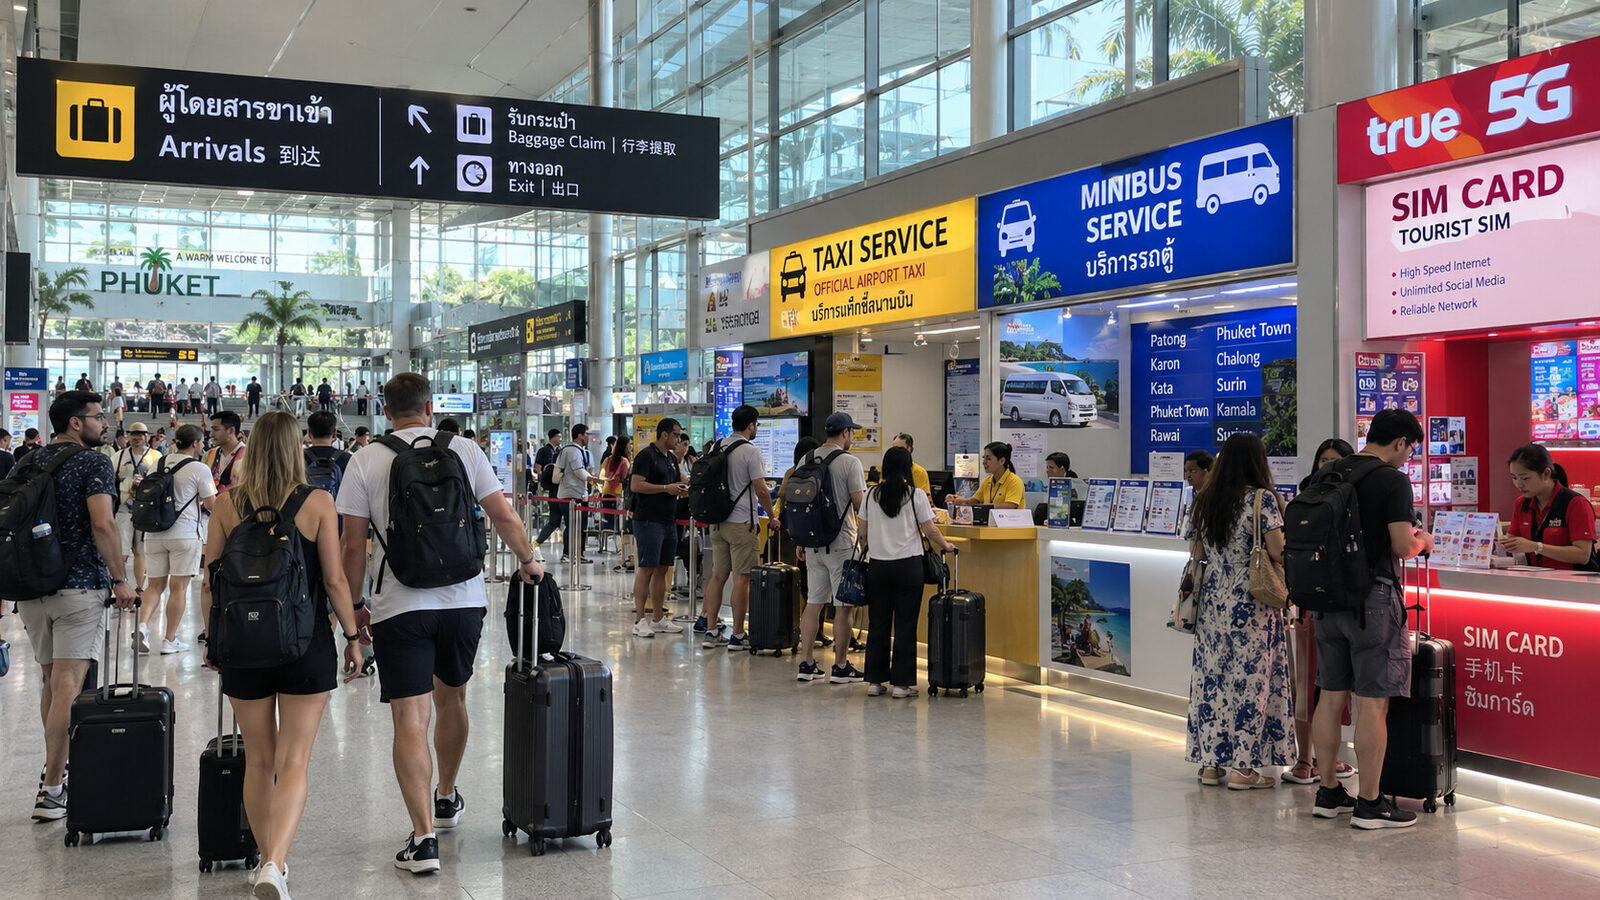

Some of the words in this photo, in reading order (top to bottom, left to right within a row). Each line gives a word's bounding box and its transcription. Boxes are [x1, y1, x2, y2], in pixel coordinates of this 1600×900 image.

[159, 82, 333, 125] ผู้โดยสารขาเข้า
[1366, 107, 1461, 156] true
[1485, 63, 1573, 136] 5G
[158, 135, 266, 164] Arrivals
[508, 130, 565, 150] Baggage
[569, 134, 606, 151] Claim
[279, 144, 322, 167] 到达
[508, 159, 564, 178] ทางออก
[509, 178, 535, 194] Exit
[551, 181, 579, 197] 出口
[1081, 162, 1182, 210] MINIBUS
[1392, 184, 1448, 222] SIM
[1461, 163, 1565, 209] CARD
[1086, 199, 1182, 243] SERVICE
[1399, 218, 1472, 245] TOURIST
[1478, 212, 1511, 233] SIM
[813, 239, 853, 272] TAXI
[860, 217, 948, 263] SERVICE
[186, 252, 214, 262] WARM
[1400, 267, 1421, 280] High
[1423, 261, 1451, 277] Speed
[1453, 256, 1491, 271] Internet
[100, 271, 220, 297] PHUKET
[814, 274, 855, 296] OFFICIAL
[857, 267, 899, 289] AIRPORT
[902, 262, 926, 281] TAXI
[1400, 282, 1443, 298] Unlimited
[1445, 278, 1473, 292] Social
[1475, 275, 1506, 288] Media
[1400, 303, 1436, 316] Reliable
[1438, 298, 1478, 312] Network
[1150, 334, 1186, 348] Patong
[1216, 326, 1256, 341] Phuket
[1259, 322, 1291, 337] Town
[1150, 358, 1180, 371] Karon
[1216, 351, 1260, 367] Chalong
[1150, 382, 1173, 395] Kata
[1216, 377, 1247, 392] Surin
[1150, 405, 1182, 418] Phuket
[1184, 404, 1209, 417] Town
[1216, 401, 1256, 417] Kamala
[1150, 428, 1180, 442] Rawai
[1463, 626, 1498, 650] SIM
[1506, 631, 1564, 658] CARD
[1464, 657, 1524, 685] 手机卡
